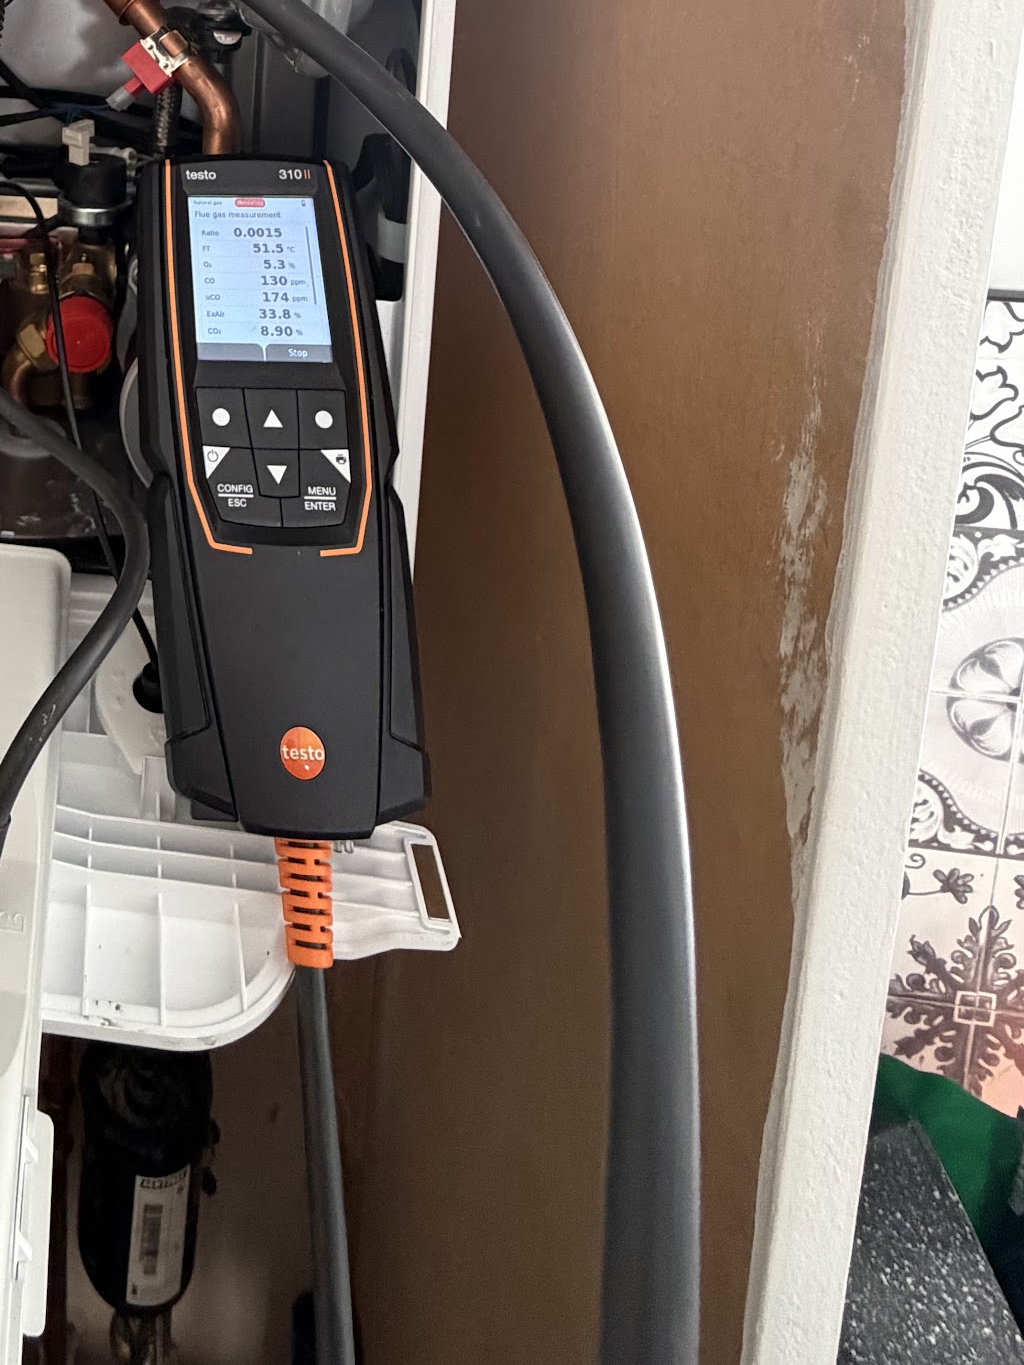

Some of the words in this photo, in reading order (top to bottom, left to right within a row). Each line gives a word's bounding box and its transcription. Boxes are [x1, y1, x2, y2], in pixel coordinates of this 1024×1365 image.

[186, 170, 217, 180] testo
[212, 212, 226, 220] gas
[234, 228, 282, 238] 0.0015
[253, 244, 284, 254] 51.5
[264, 260, 286, 270] 5.3
[261, 276, 288, 286] 130
[262, 292, 290, 302] 174
[259, 309, 291, 319] 33.8
[260, 326, 293, 336] 8.90
[288, 348, 308, 358] Stop
[217, 484, 254, 493] CONFIG
[308, 486, 336, 495] MENU
[228, 498, 247, 507] ESC
[304, 502, 336, 511] ENTER
[282, 745, 325, 761] testo
